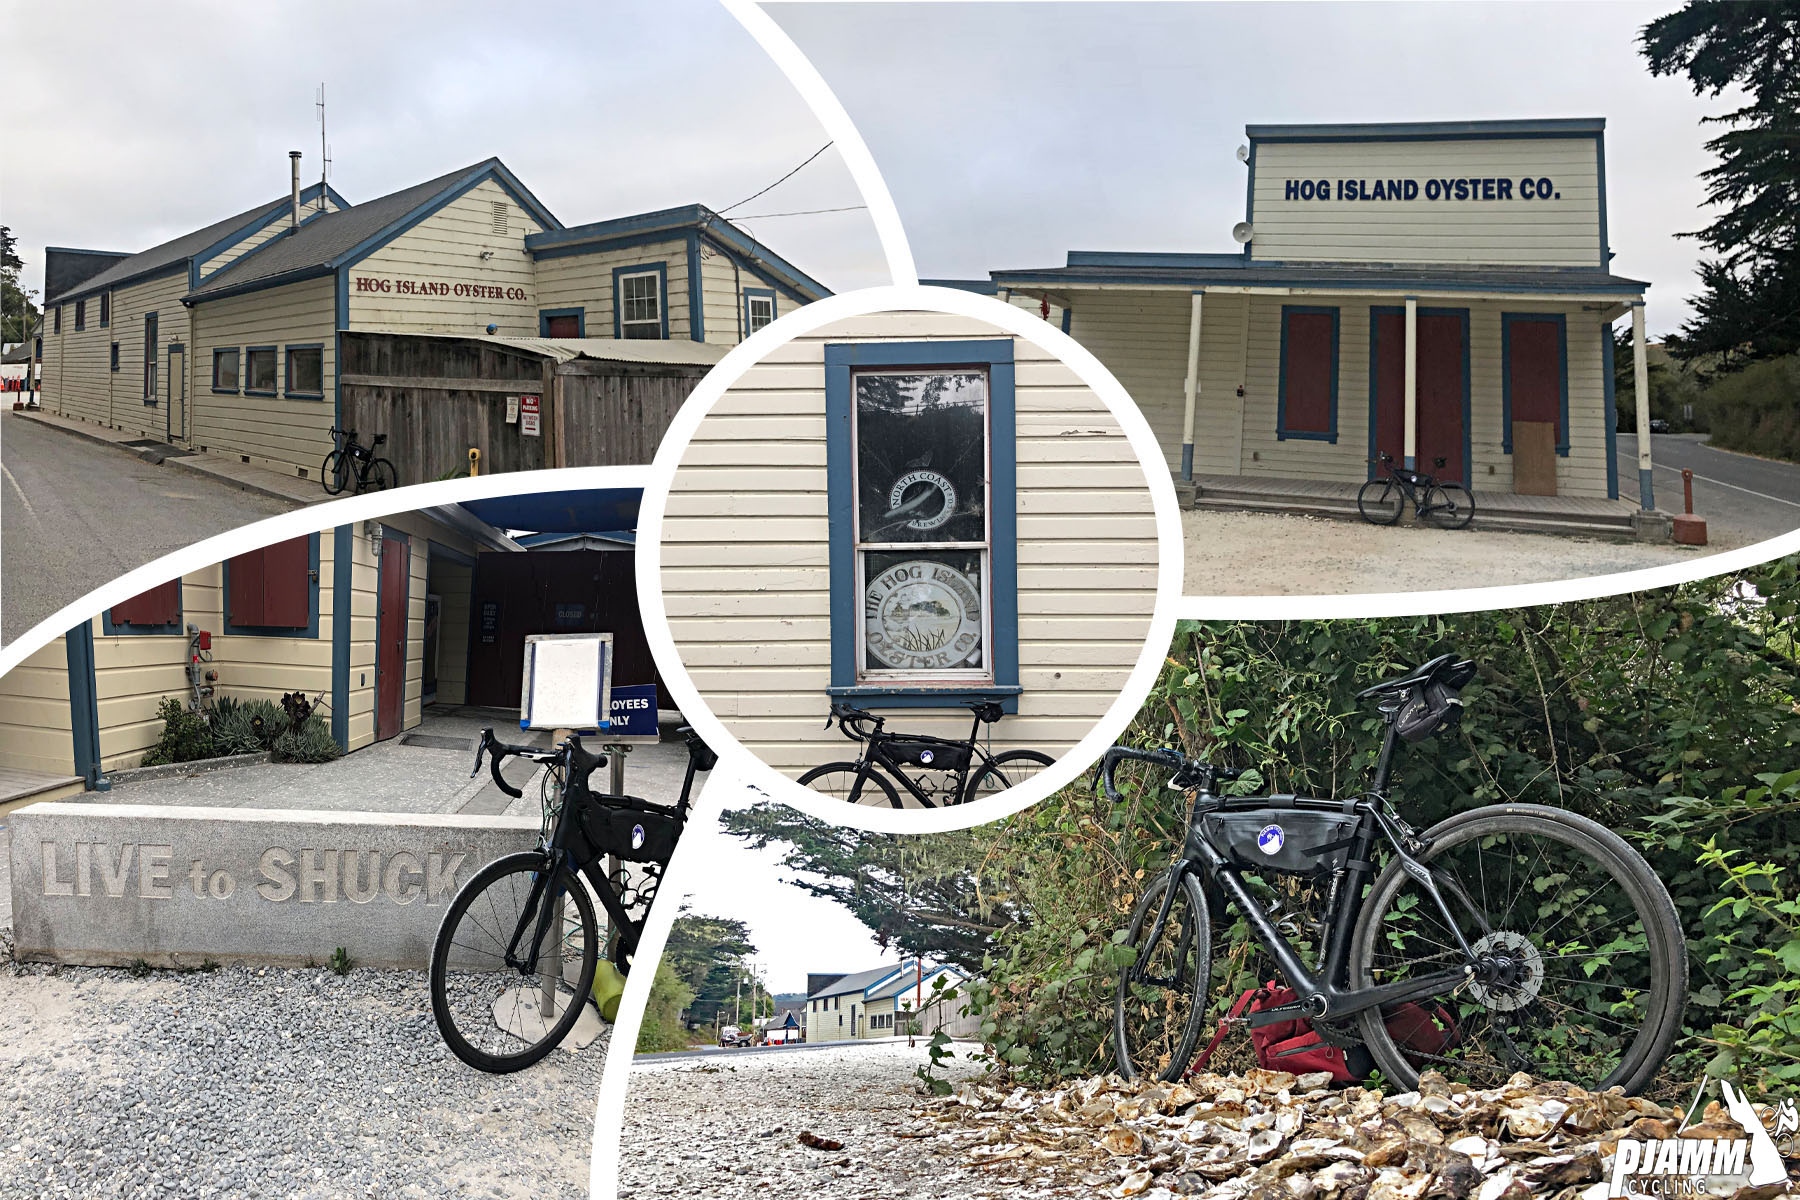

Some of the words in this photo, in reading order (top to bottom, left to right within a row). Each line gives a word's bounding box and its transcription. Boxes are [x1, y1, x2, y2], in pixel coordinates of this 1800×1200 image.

[1285, 180, 1330, 201] HOG
[1337, 180, 1418, 201] ISLAND
[1425, 178, 1513, 200] OYSTER
[1520, 178, 1561, 200] CO.
[356, 277, 392, 293] HOG
[396, 280, 450, 296] ISLAND
[454, 283, 504, 299] OYSTER
[506, 287, 527, 301] CO.
[893, 475, 917, 507] NORTH
[920, 473, 952, 492] COAST
[881, 566, 922, 590] HOG
[558, 610, 582, 618] CLOSED
[610, 699, 649, 710] OYEES
[610, 716, 630, 726] NLY
[41, 841, 172, 899] LIVE
[190, 860, 236, 899] to
[257, 845, 467, 906] SHUCK
